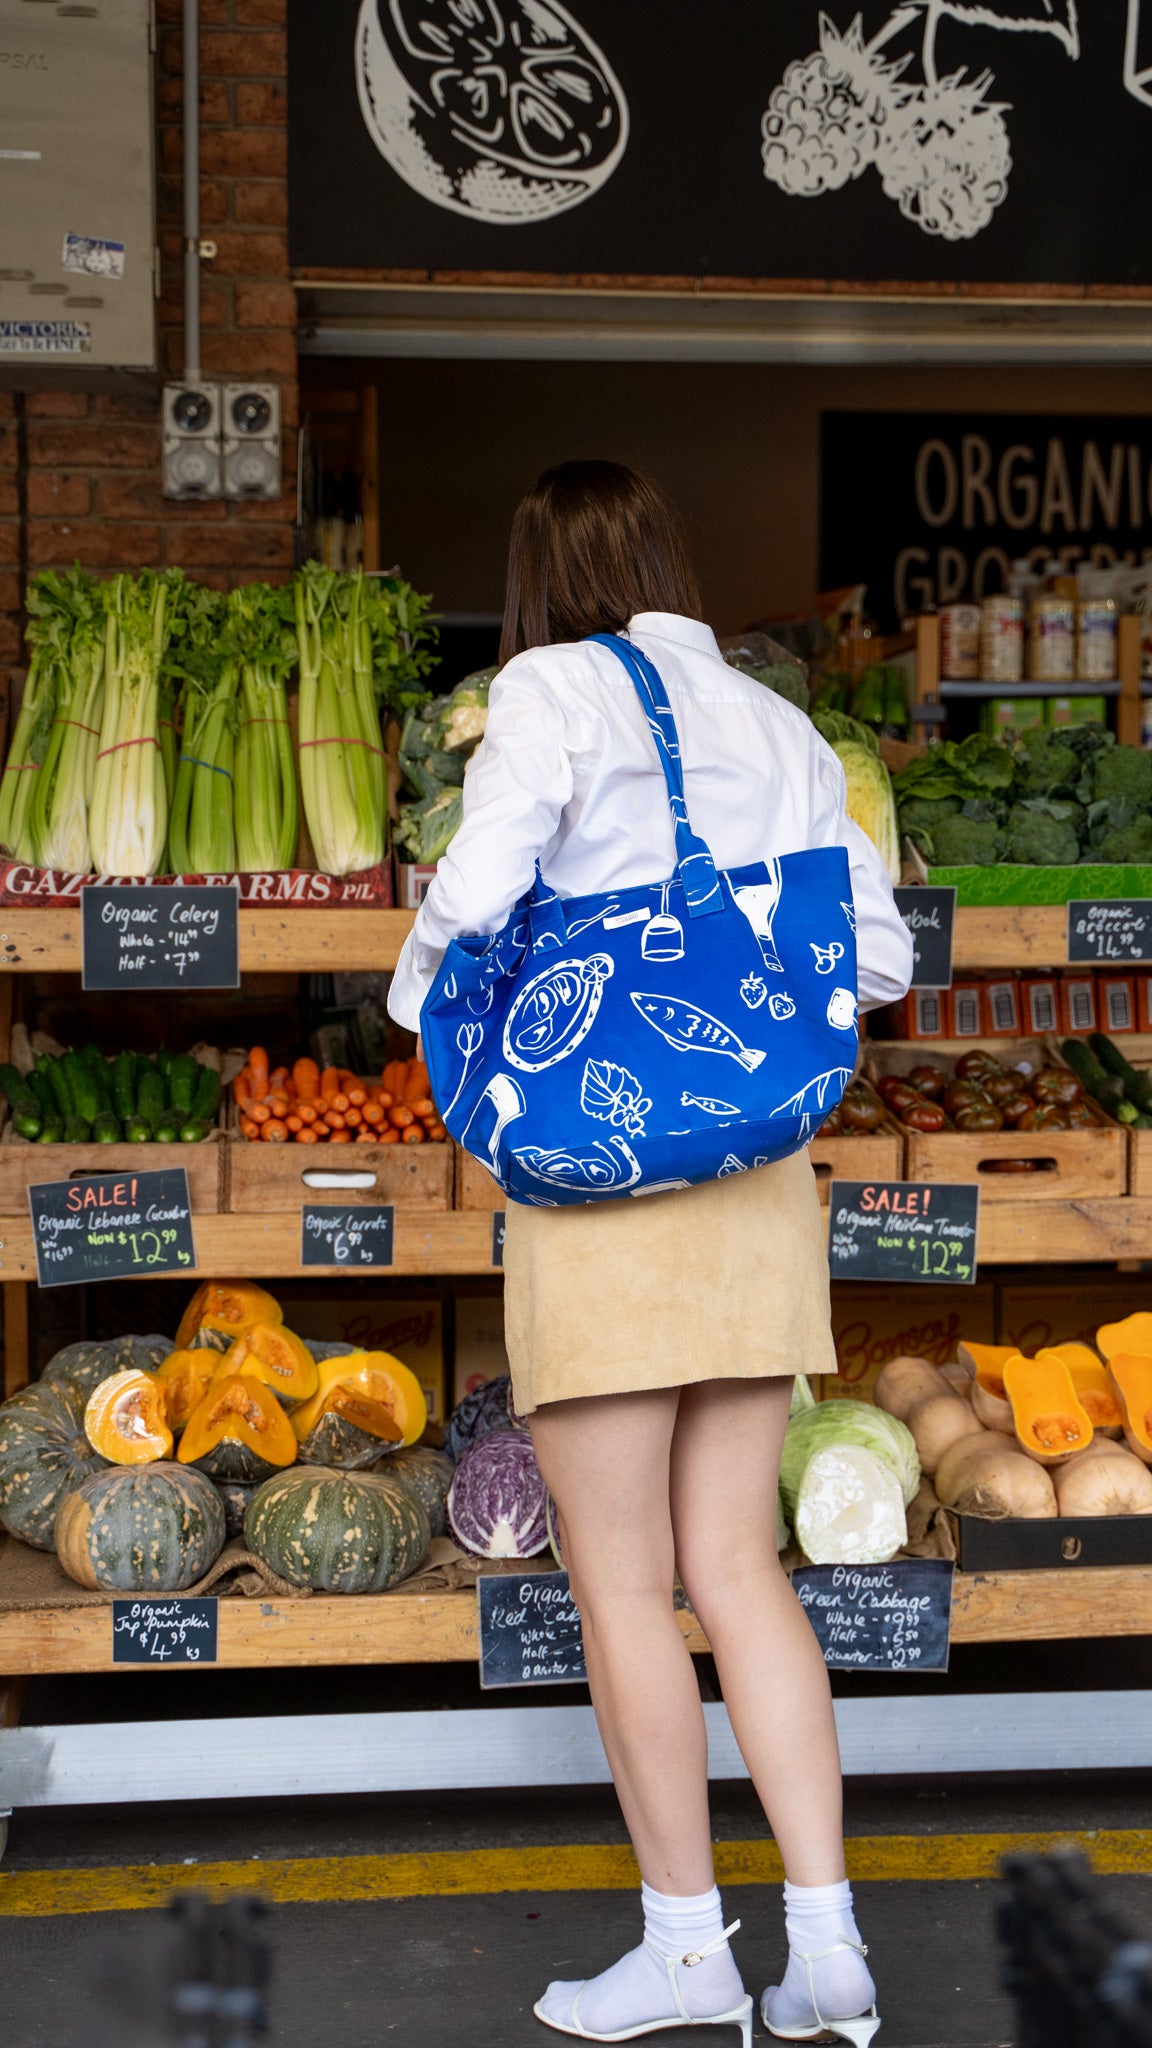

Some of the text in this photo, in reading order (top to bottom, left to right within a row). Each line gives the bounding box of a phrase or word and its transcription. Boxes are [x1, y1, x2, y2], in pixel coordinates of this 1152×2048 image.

[914, 432, 1152, 534] ORGANI
[101, 901, 219, 935] Organic Celery
[1087, 905, 1134, 926] Organic
[118, 954, 146, 971] Half
[66, 1178, 138, 1212] SALE!
[860, 1186, 931, 1216] SALE!
[38, 1214, 85, 1240] Organic
[305, 1213, 389, 1238] Organic Carrots
[836, 1207, 883, 1235] Organic
[831, 1565, 894, 1600] Organic
[798, 1583, 931, 1614] Green Cabbage
[130, 1601, 183, 1626] Organic
[490, 1606, 528, 1630] Red
[825, 1611, 866, 1627] Whole
[114, 1615, 141, 1638] Jap
[828, 1625, 858, 1642] Half
[186, 1646, 200, 1660] kg
[522, 1645, 549, 1660] Half
[823, 1647, 873, 1664] Quarter
